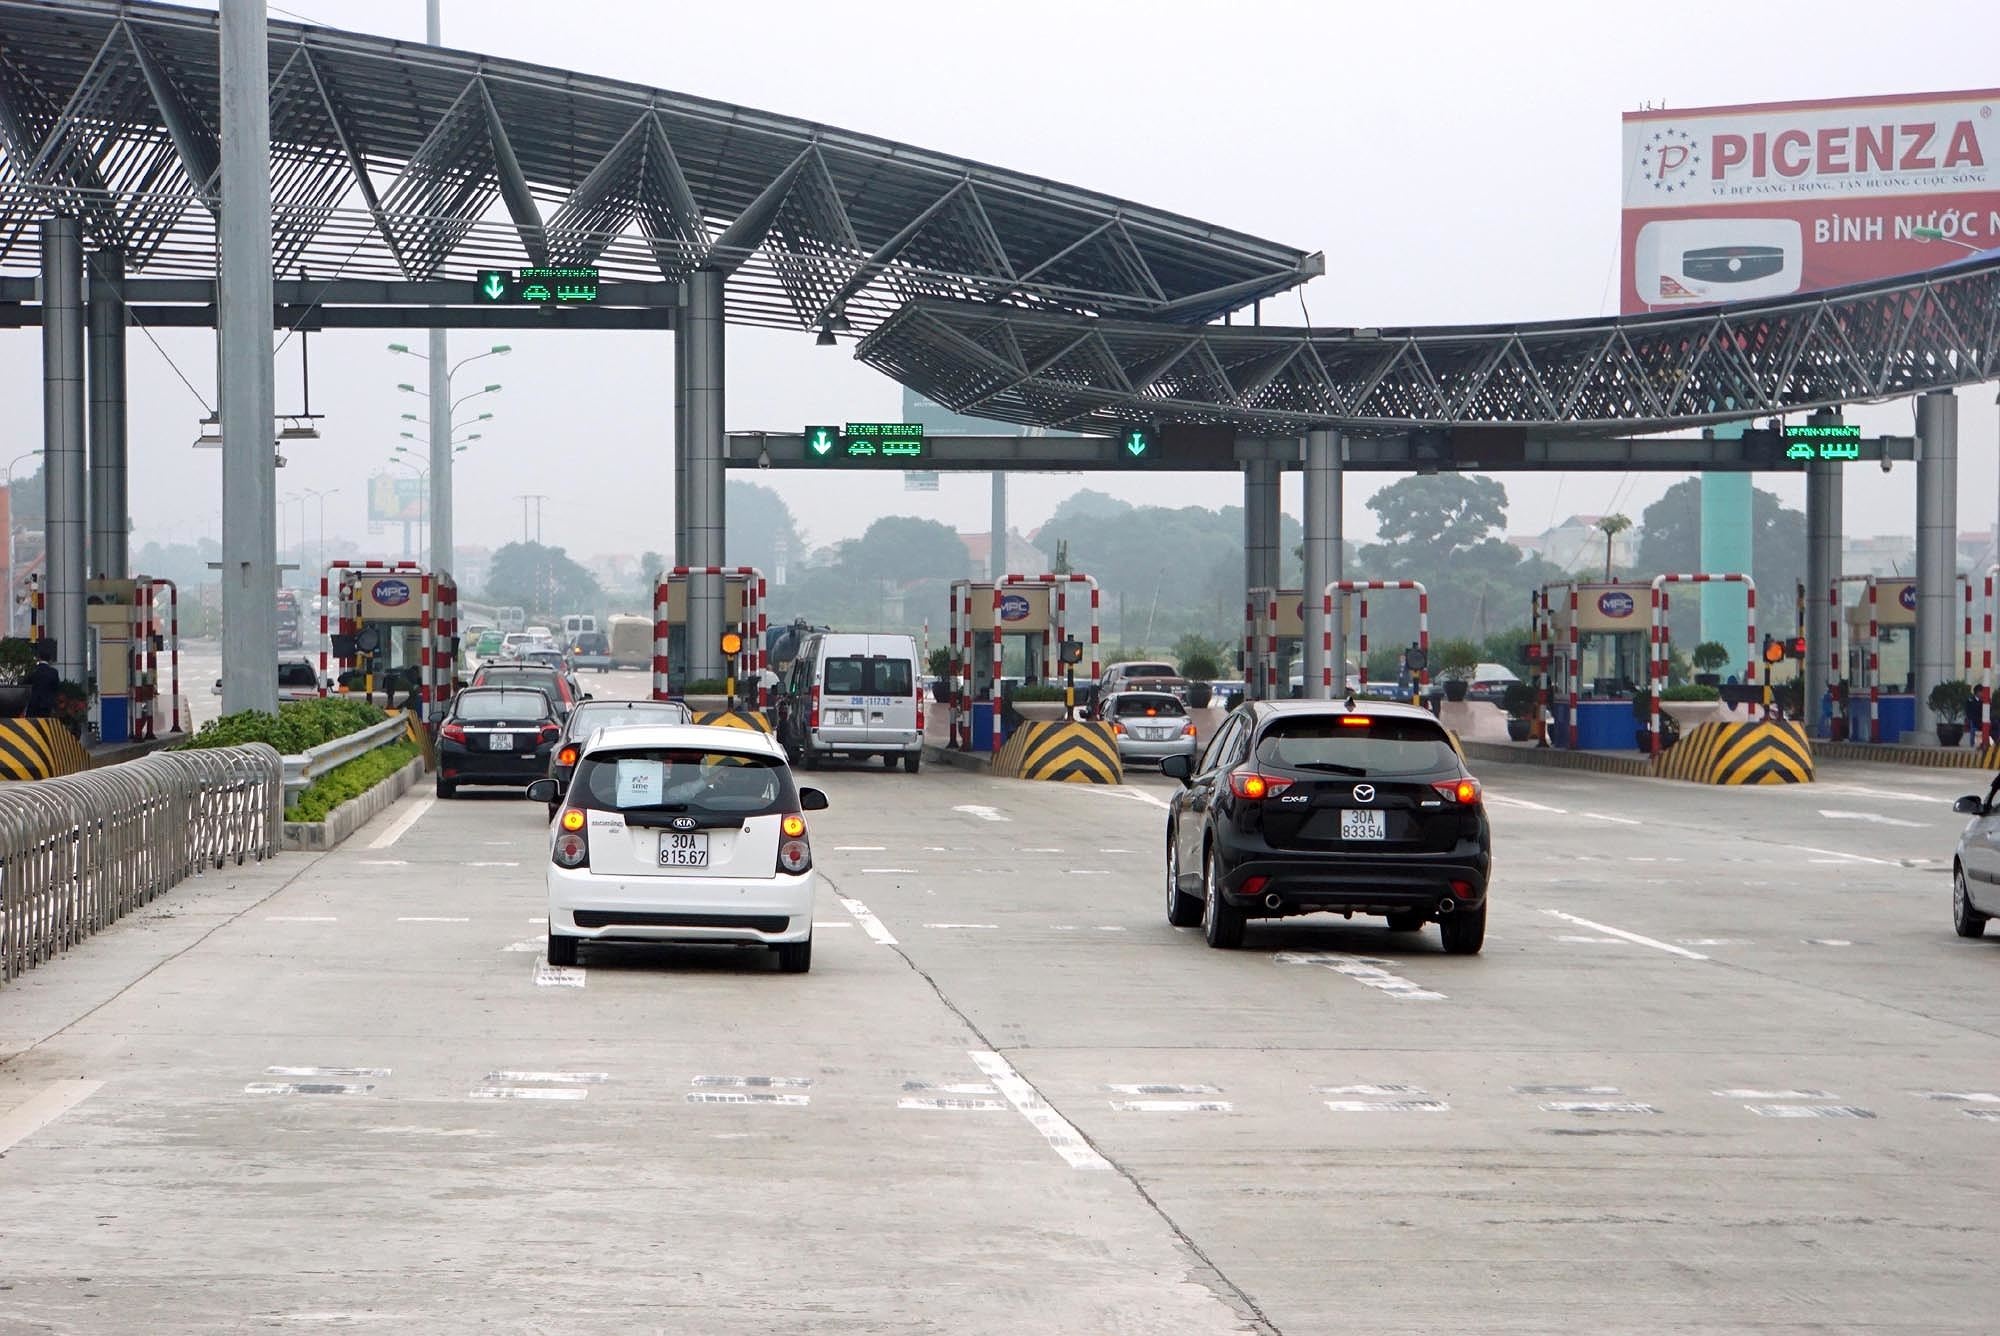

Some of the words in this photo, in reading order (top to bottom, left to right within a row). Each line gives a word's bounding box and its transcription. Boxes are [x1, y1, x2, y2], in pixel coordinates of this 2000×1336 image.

[1711, 120, 1985, 181] PICENZA
[1814, 213, 1884, 244] BÌNH
[376, 586, 408, 598] MPC
[1602, 599, 1633, 609] MPC
[675, 819, 693, 827] KIA
[1351, 810, 1375, 824] 30A
[1342, 825, 1384, 839] 833.54
[671, 834, 696, 849] 30A
[660, 850, 706, 865] 815.67
